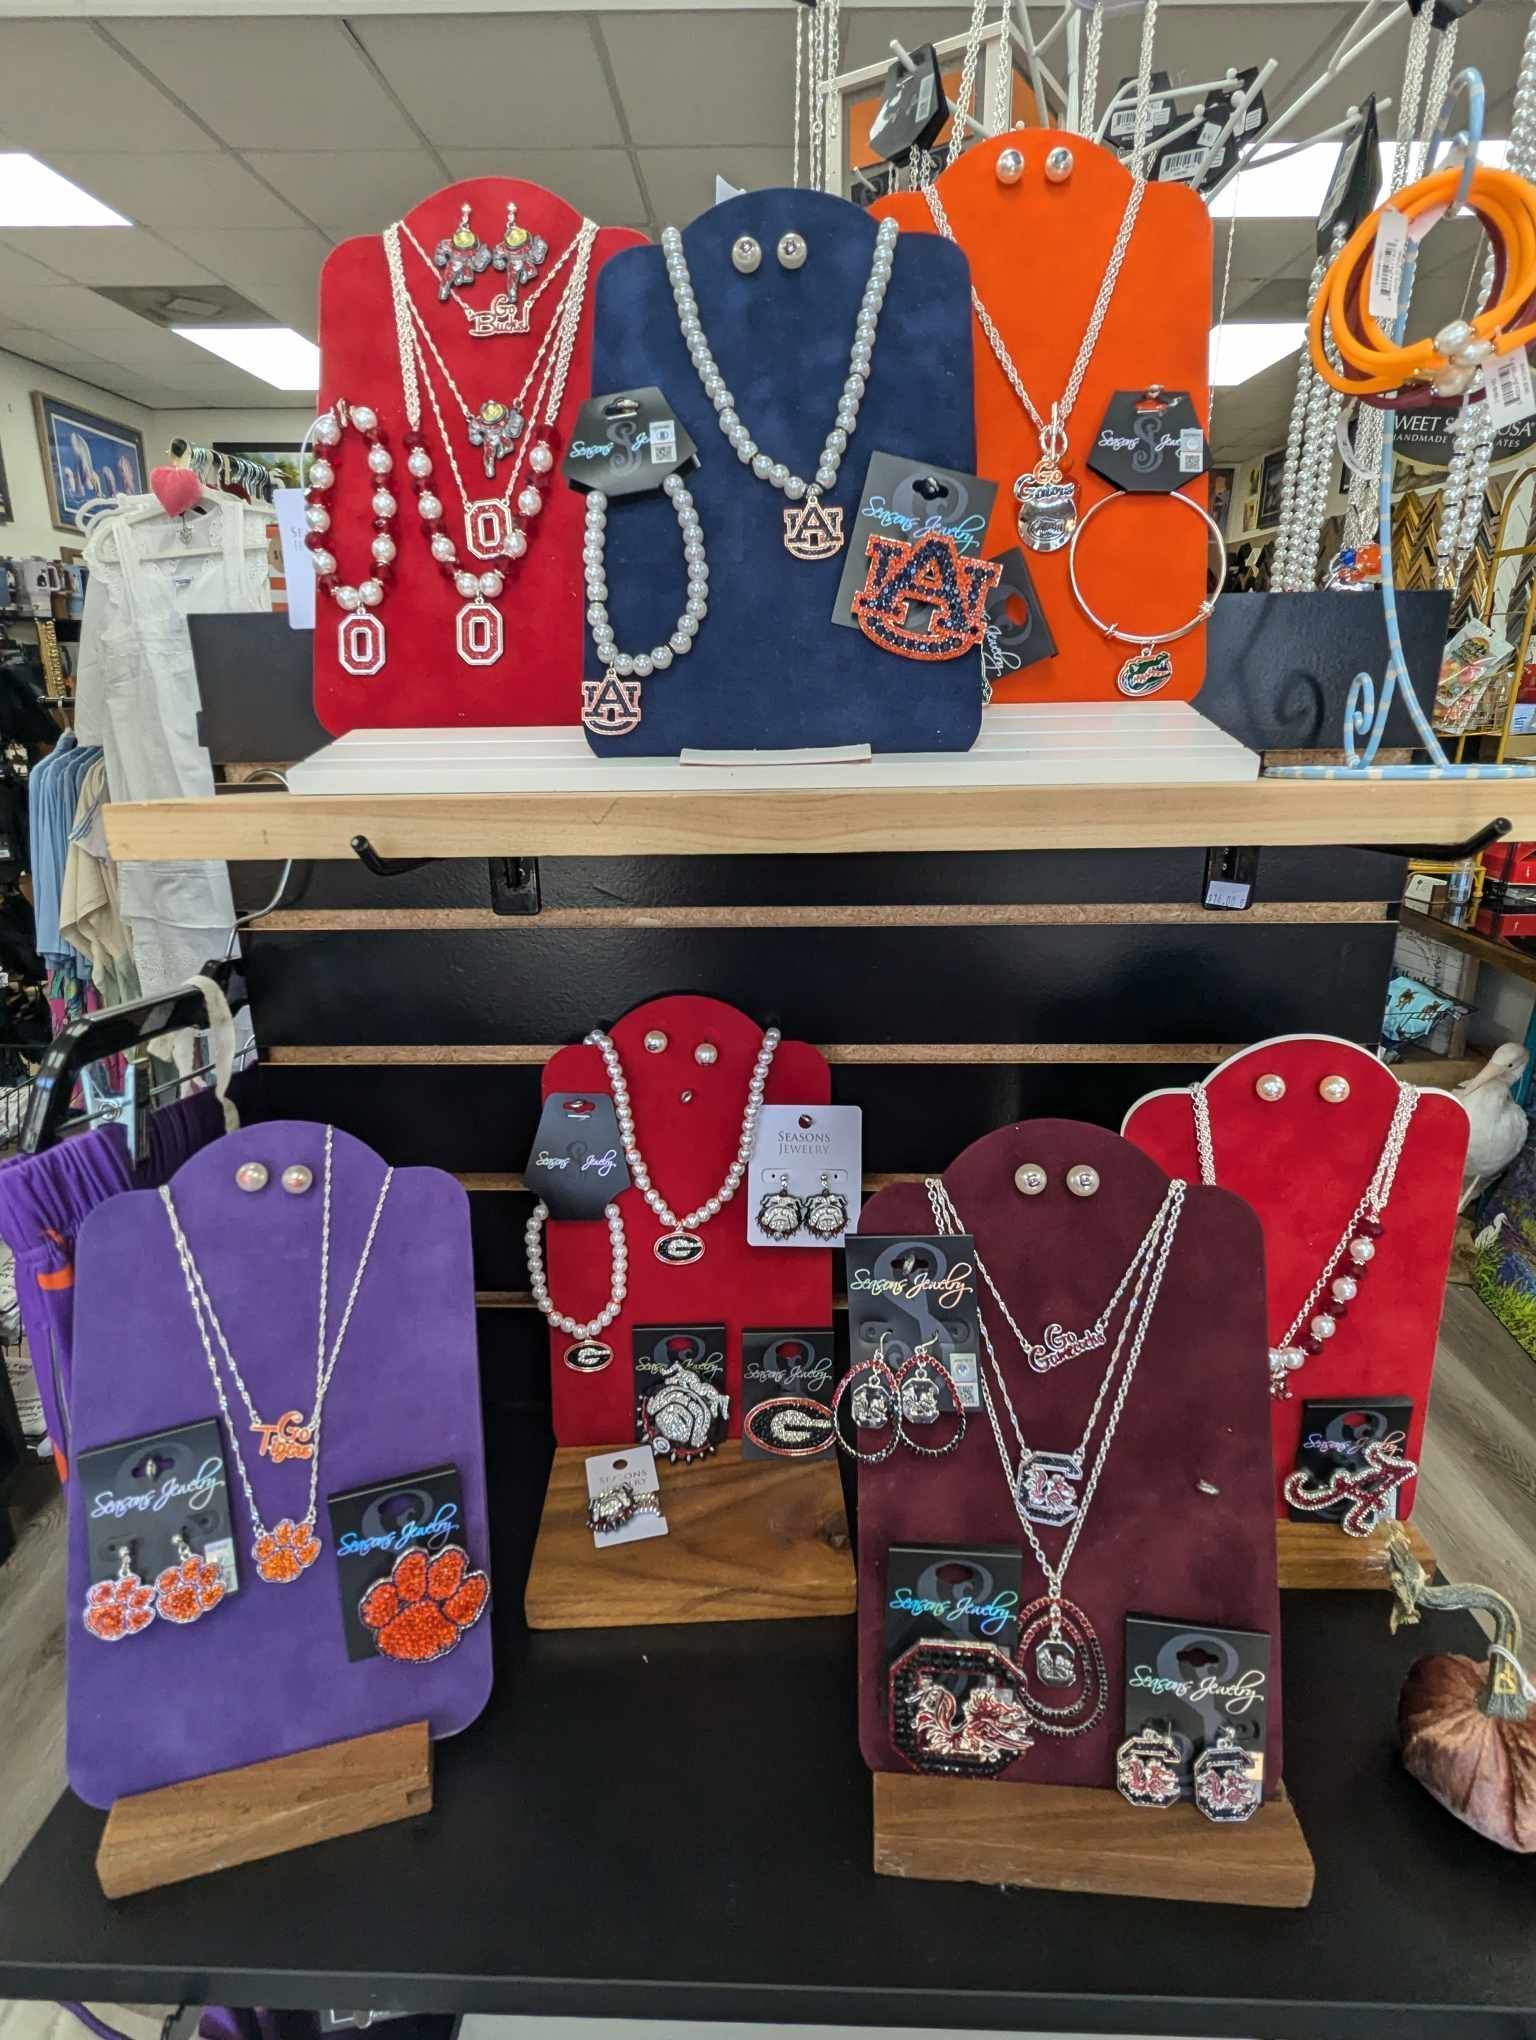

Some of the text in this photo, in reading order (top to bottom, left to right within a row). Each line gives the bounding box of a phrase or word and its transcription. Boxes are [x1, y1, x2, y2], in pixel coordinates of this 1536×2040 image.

[489, 294, 518, 317] Go
[1393, 433, 1449, 444] ANDMADE
[1394, 415, 1442, 432] WEET
[1098, 429, 1140, 451] Seasons
[1013, 473, 1076, 503] Gators
[1033, 461, 1063, 485] Go
[861, 495, 921, 532] Seasons
[535, 1149, 617, 1177] Seasons Jewelry
[850, 1262, 974, 1310] Seasons Jewelry
[1044, 1323, 1078, 1352] Go
[744, 1357, 833, 1392] Seasons Jewelry
[278, 1410, 312, 1442] Go
[90, 1456, 226, 1519] Seasons Jewelry
[336, 1502, 460, 1557] Seasons Jewelry
[889, 1587, 1018, 1636] Seasons Jewelry
[1128, 1664, 1266, 1716] Seasons Jewelry
